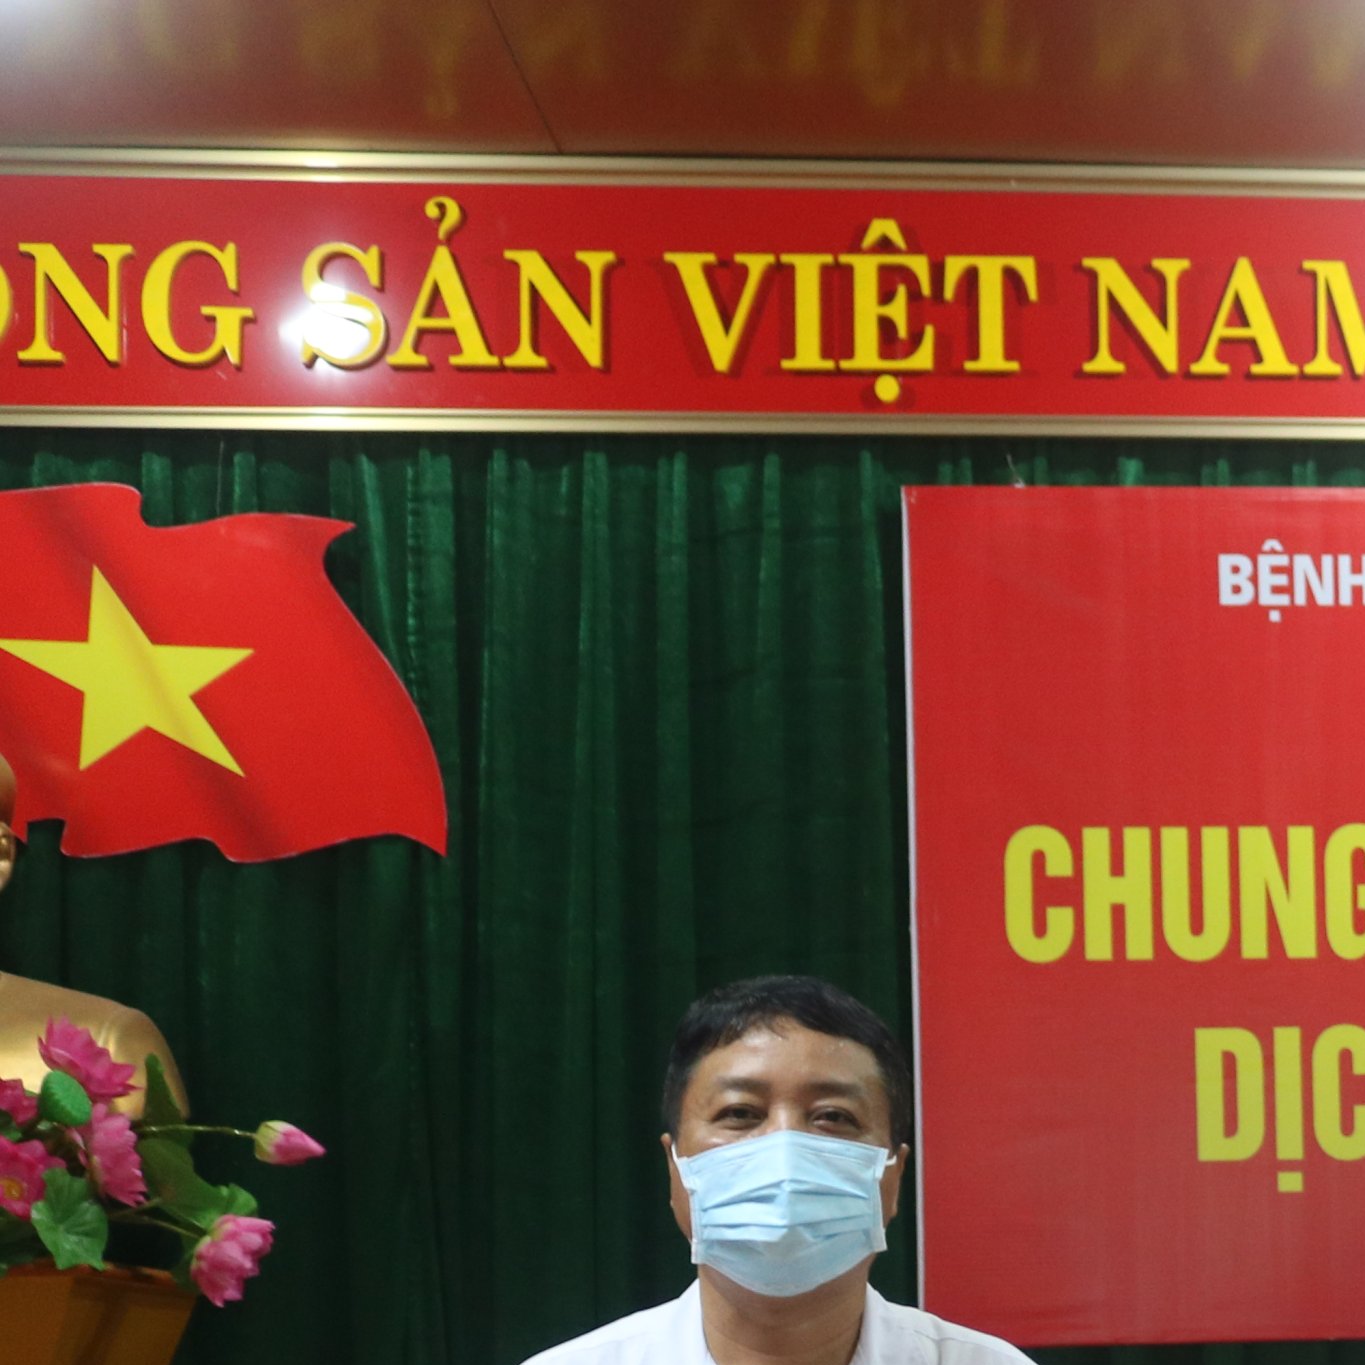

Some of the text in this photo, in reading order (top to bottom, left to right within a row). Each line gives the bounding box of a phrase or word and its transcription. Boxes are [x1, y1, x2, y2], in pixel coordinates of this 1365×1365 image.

[0, 241, 253, 364] NG
[302, 196, 617, 369] SẢN
[665, 218, 1038, 403] VIỆT
